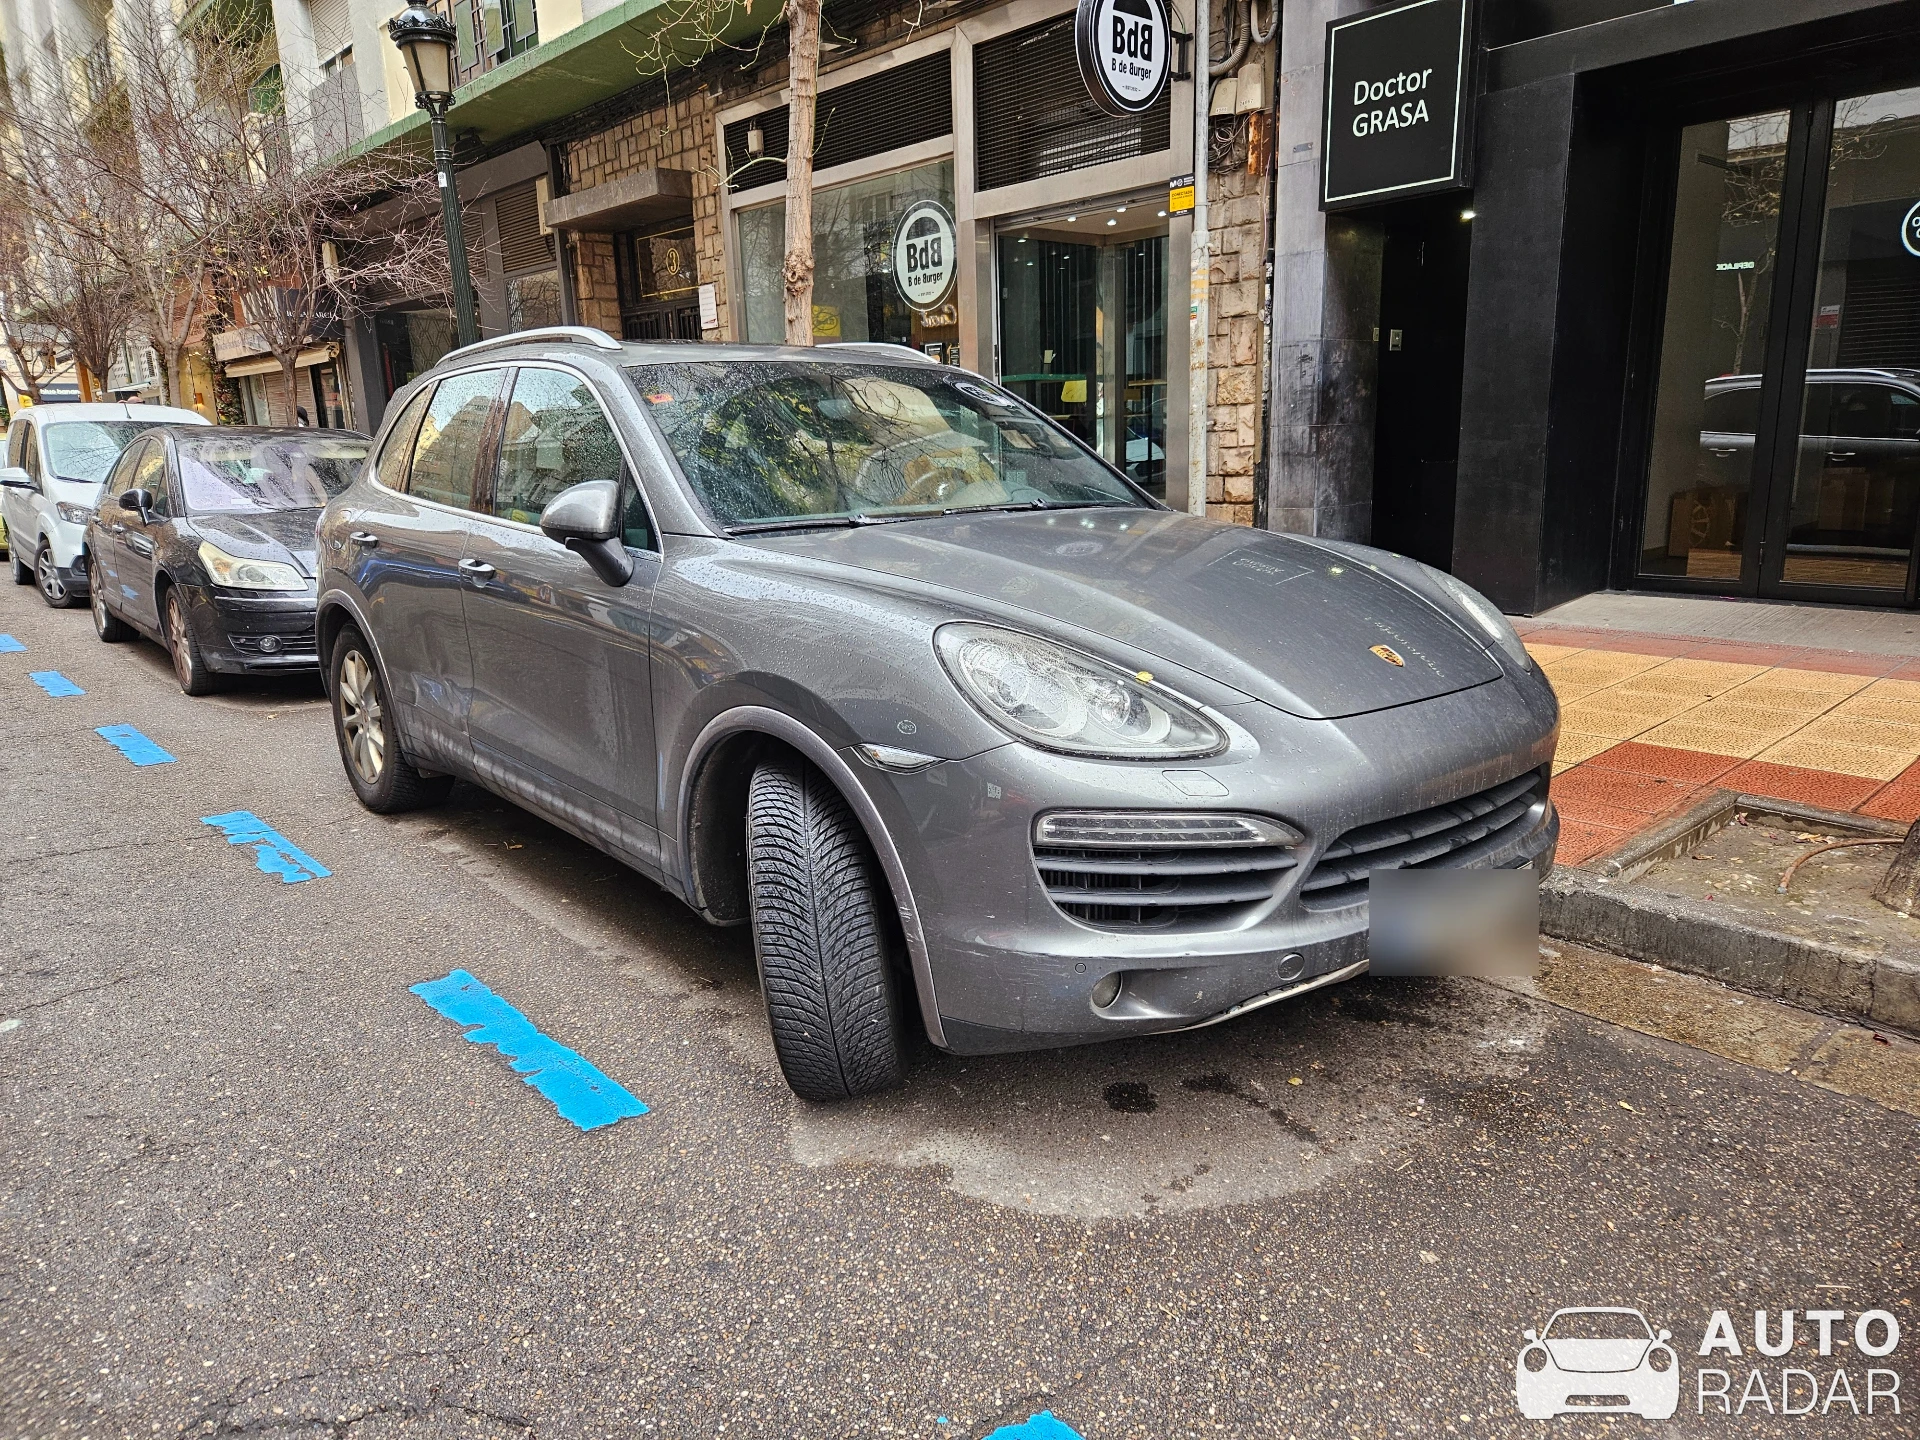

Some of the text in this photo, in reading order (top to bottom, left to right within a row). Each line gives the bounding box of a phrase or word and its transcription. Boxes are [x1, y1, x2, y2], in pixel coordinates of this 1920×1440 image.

[1111, 57, 1152, 81] B de Burger
[1353, 68, 1433, 106] Doctor
[1352, 99, 1430, 137] GRASA
[669, 251, 677, 272] 3
[907, 271, 944, 287] B de Burger
